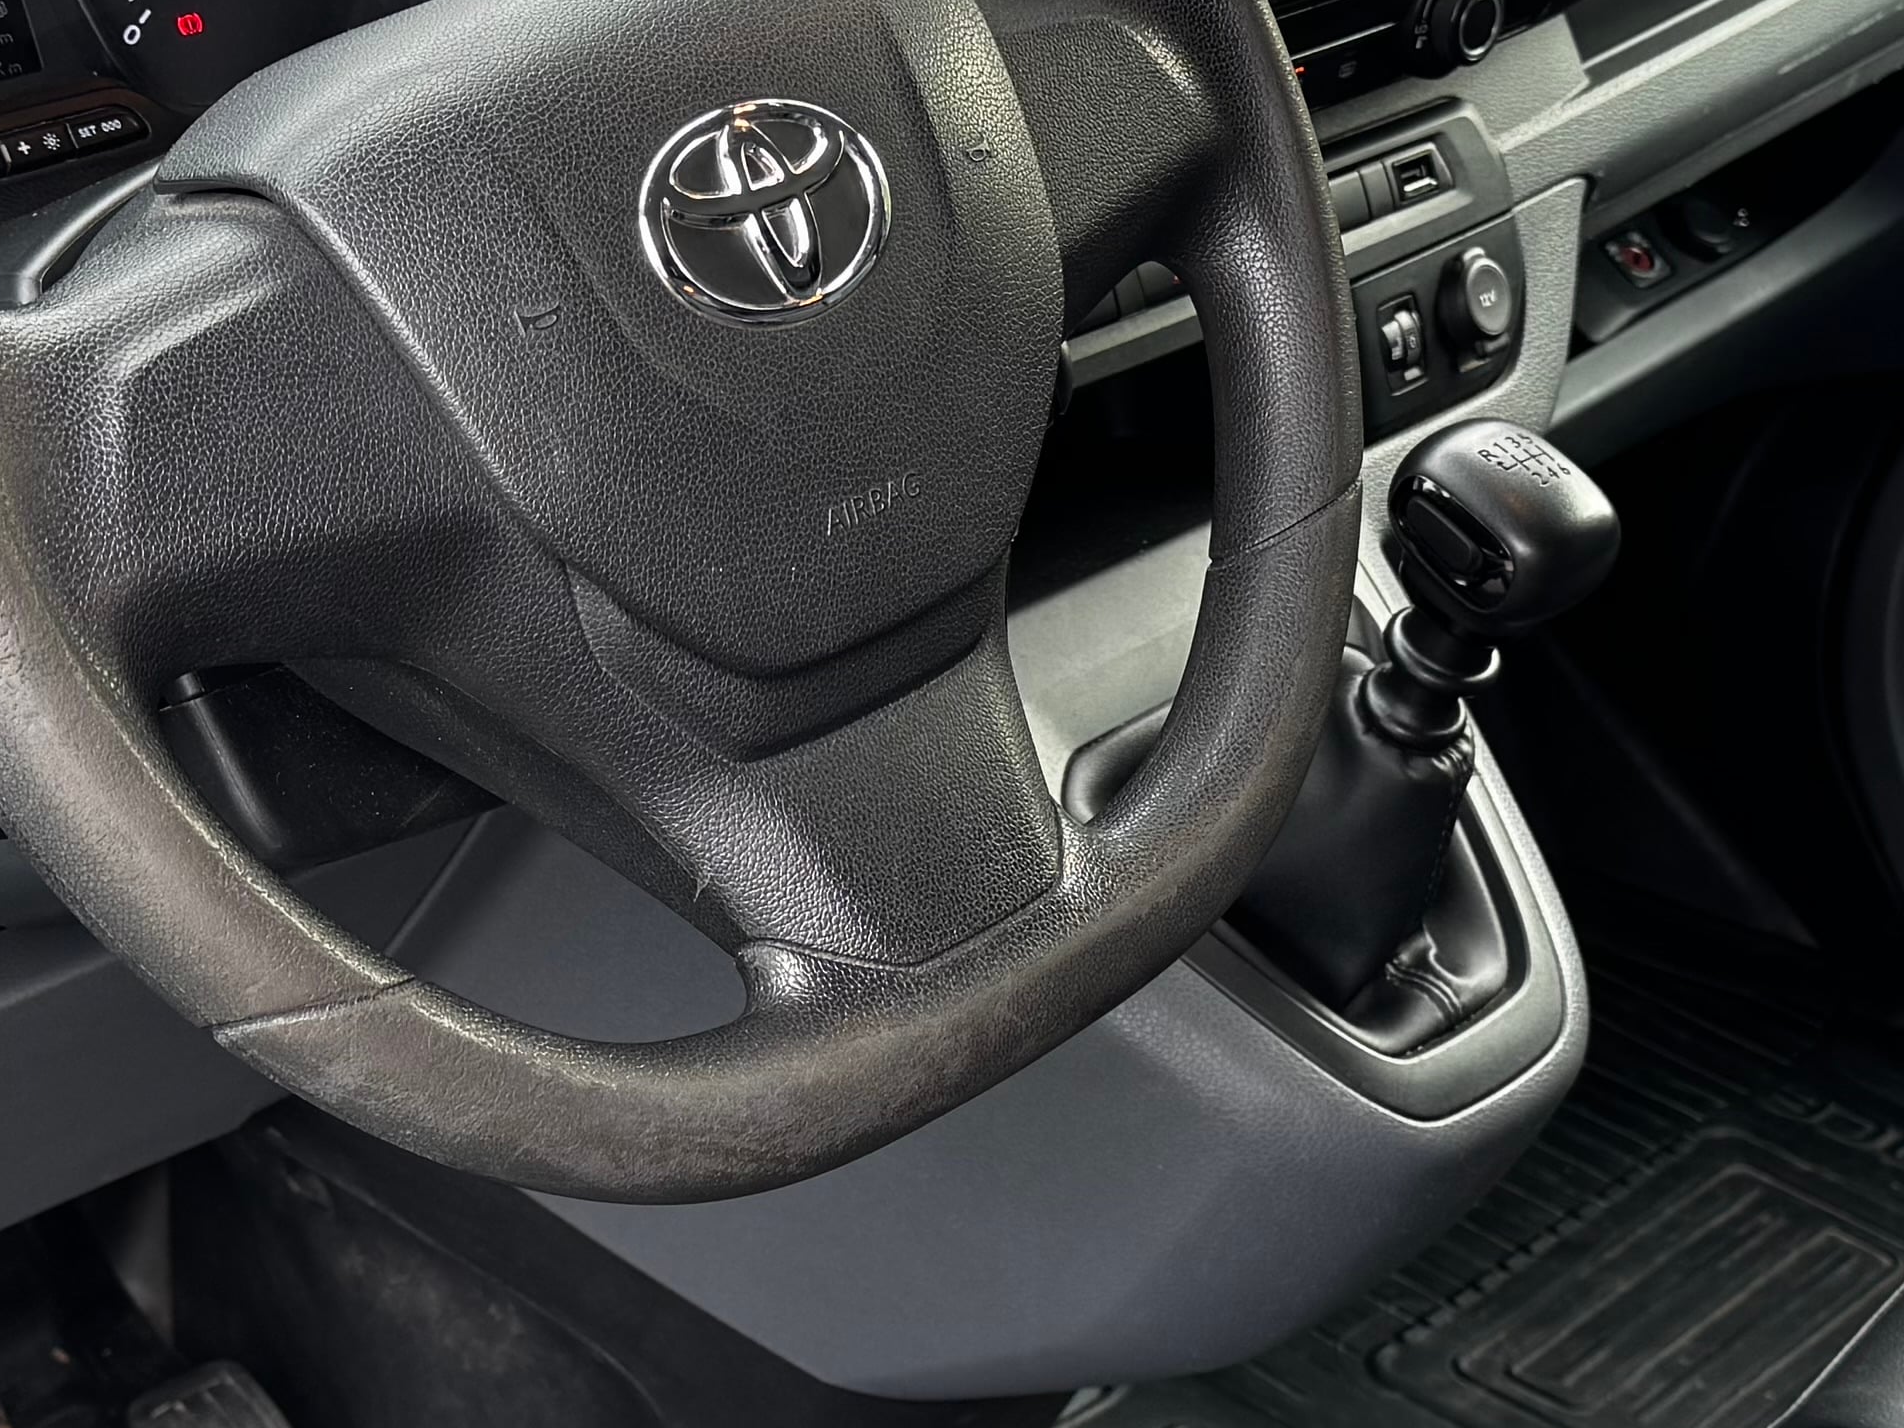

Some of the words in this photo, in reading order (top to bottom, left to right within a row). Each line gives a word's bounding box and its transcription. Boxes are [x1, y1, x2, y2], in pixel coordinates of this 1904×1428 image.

[121, 23, 142, 46] 0
[77, 124, 97, 139] SET
[1477, 448, 1501, 463] R
[1504, 435, 1522, 449] 3
[827, 472, 921, 537] AIRBAG
